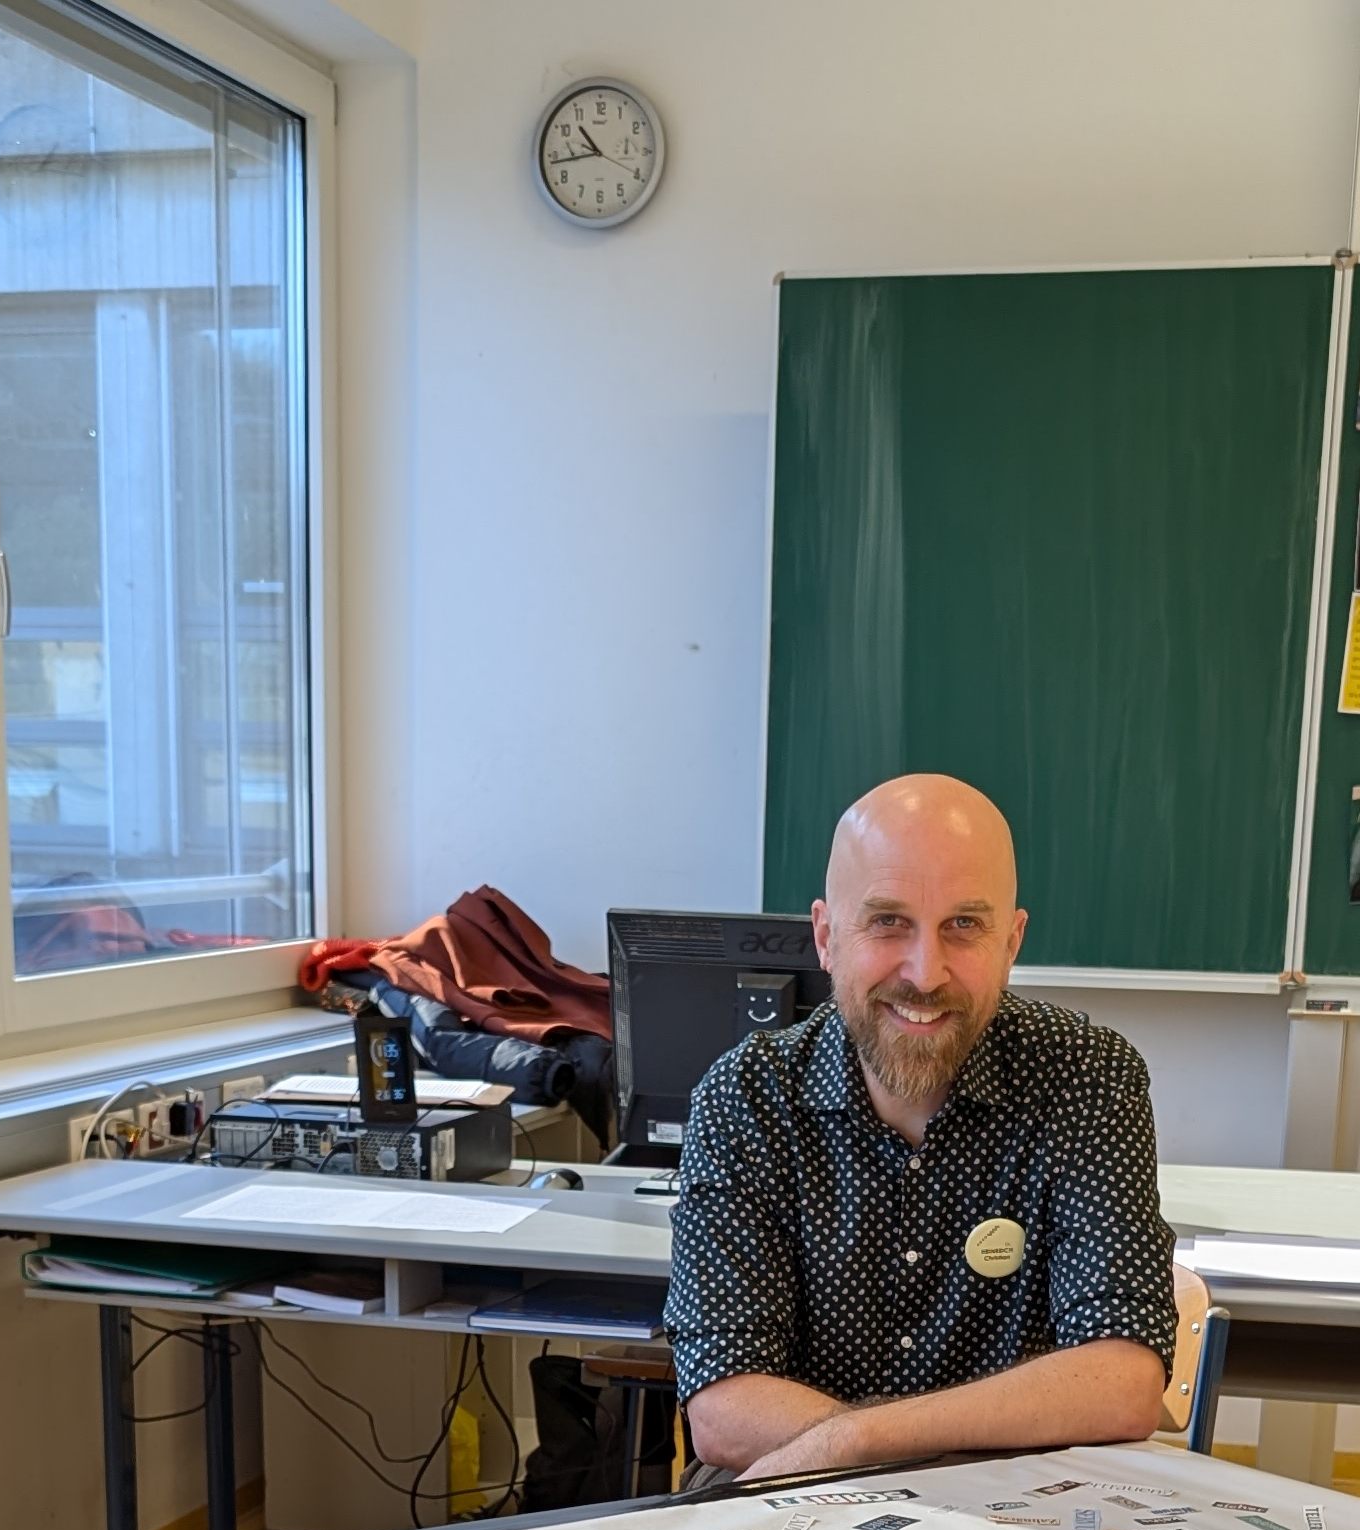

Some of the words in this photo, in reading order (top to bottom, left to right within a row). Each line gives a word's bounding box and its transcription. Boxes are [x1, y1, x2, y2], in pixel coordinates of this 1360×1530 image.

[574, 108, 584, 121] 11
[596, 101, 606, 115] 12
[560, 124, 571, 137] 10
[632, 121, 640, 134] 2
[560, 170, 568, 184] 8
[578, 184, 585, 198] 7
[596, 190, 604, 204] 6
[616, 183, 624, 197] 5
[771, 1489, 901, 1507] SCHRITT
